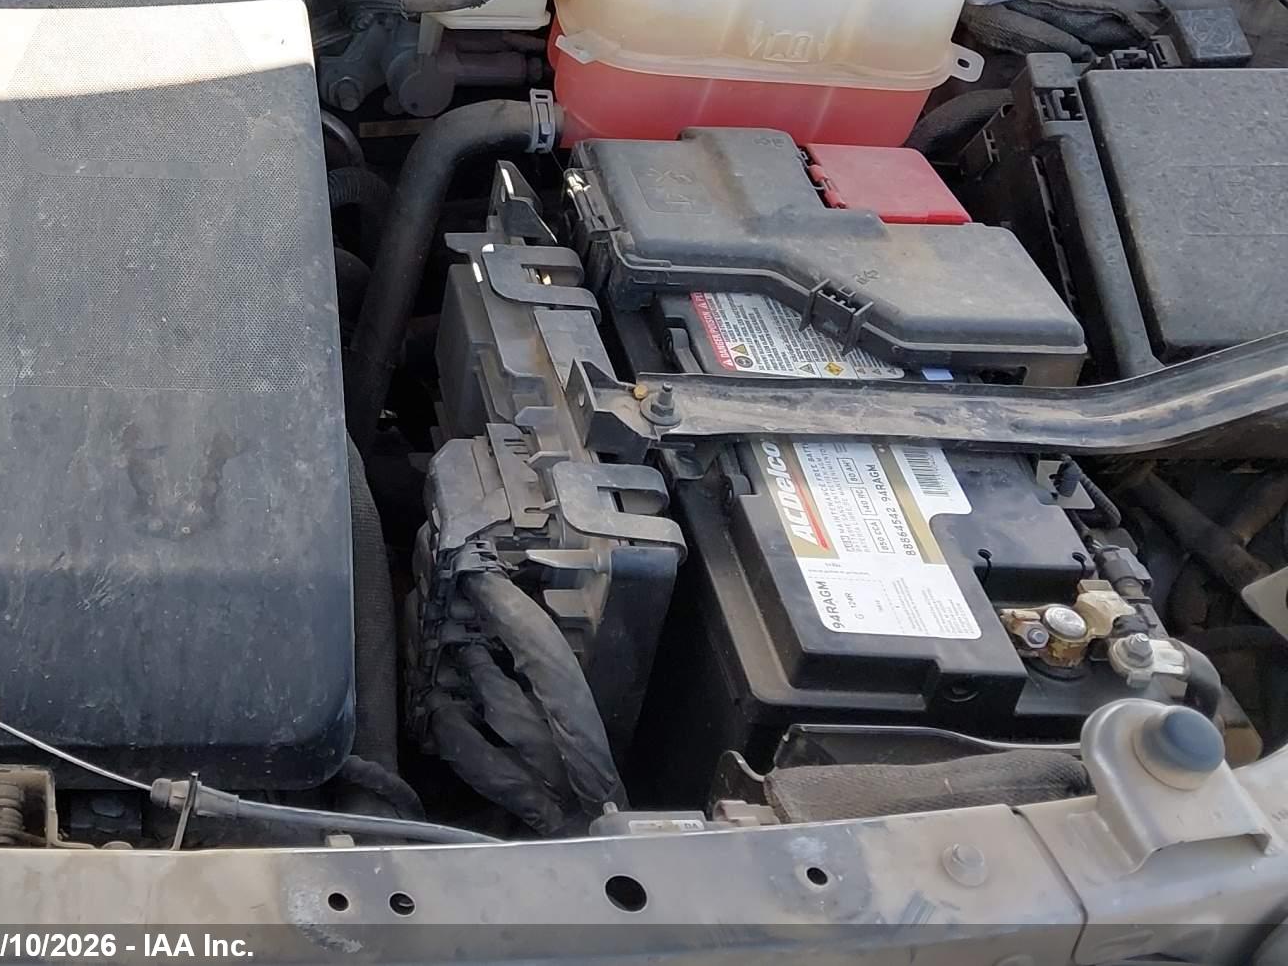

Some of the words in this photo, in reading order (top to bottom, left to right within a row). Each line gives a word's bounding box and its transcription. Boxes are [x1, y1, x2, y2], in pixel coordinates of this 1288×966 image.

[761, 442, 820, 546] ACDelco
[863, 463, 892, 502] 94RAGM
[815, 580, 845, 629] 94RAGM
